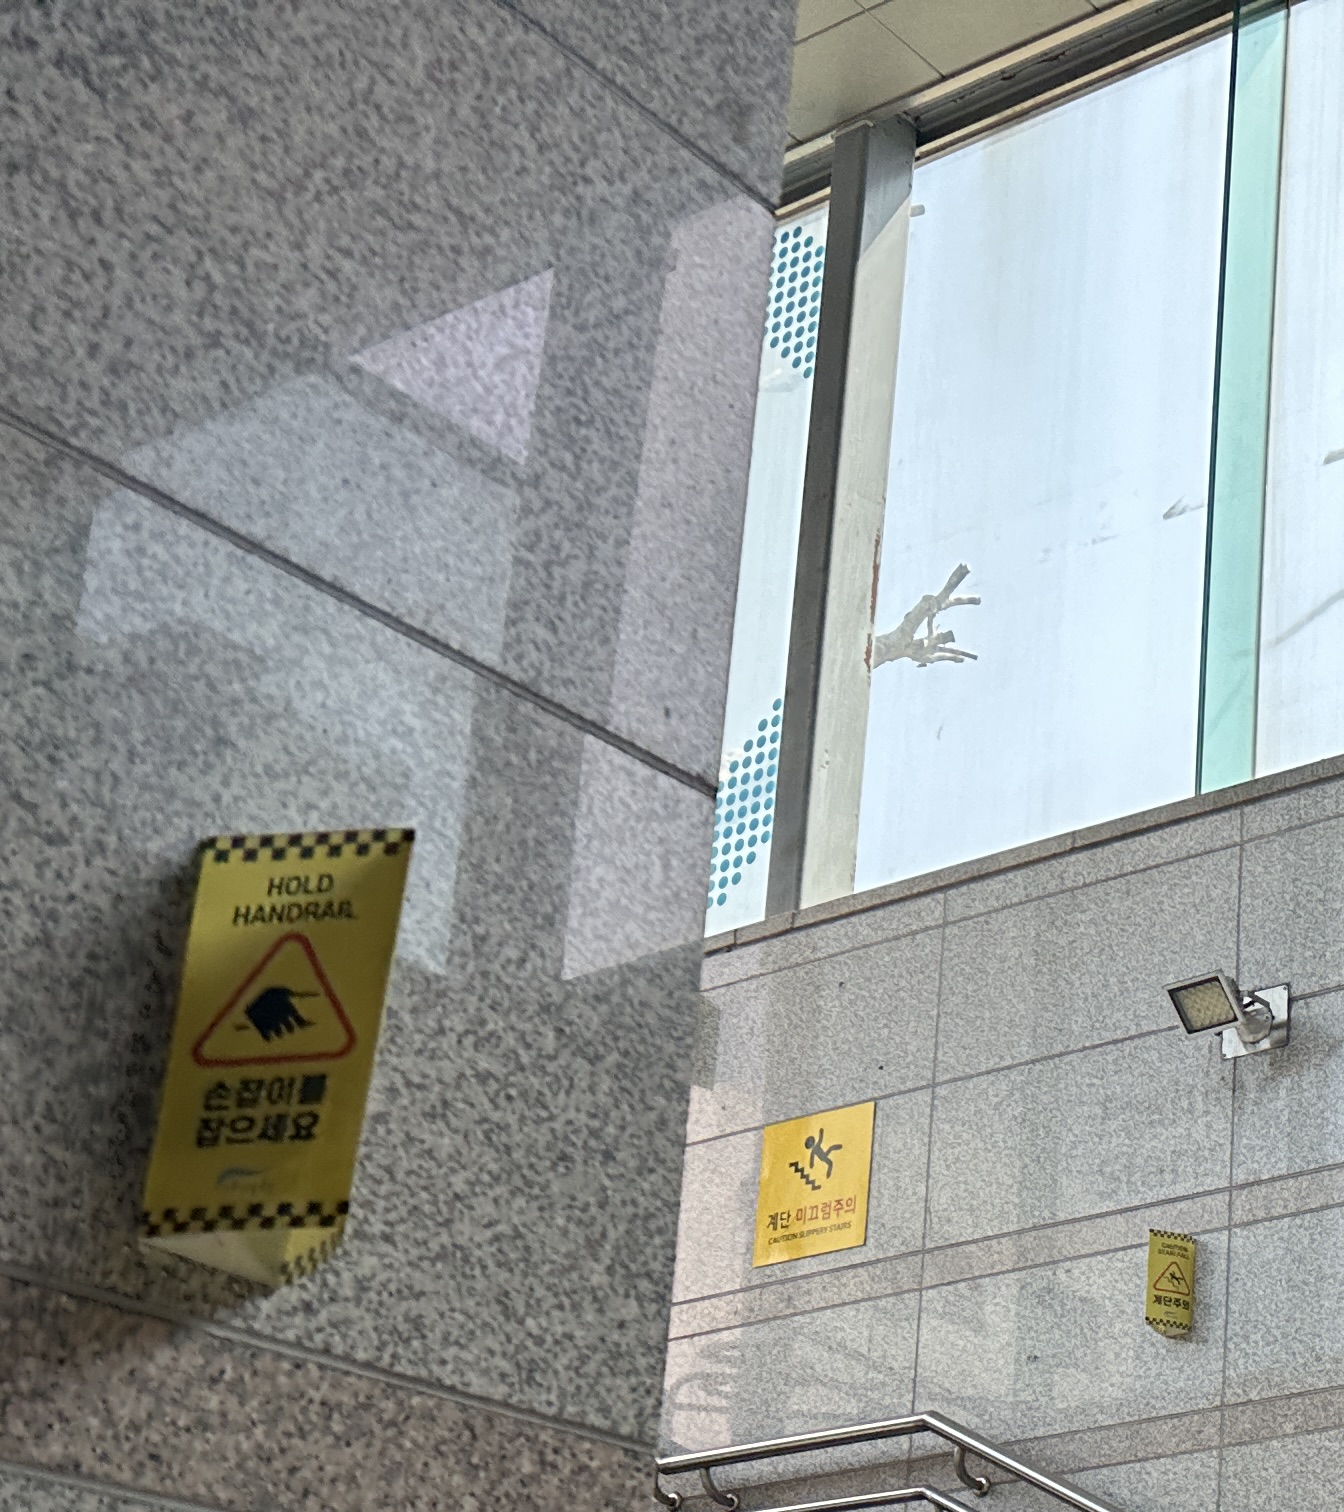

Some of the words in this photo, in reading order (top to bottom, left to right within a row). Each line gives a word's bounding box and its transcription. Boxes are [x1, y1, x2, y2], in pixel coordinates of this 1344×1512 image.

[267, 873, 334, 897] HOLD
[203, 1073, 328, 1112] 손잡이
[196, 1110, 320, 1148] 잡으세요
[766, 1209, 792, 1231] 계단
[795, 1194, 857, 1225] 미끄럼주의
